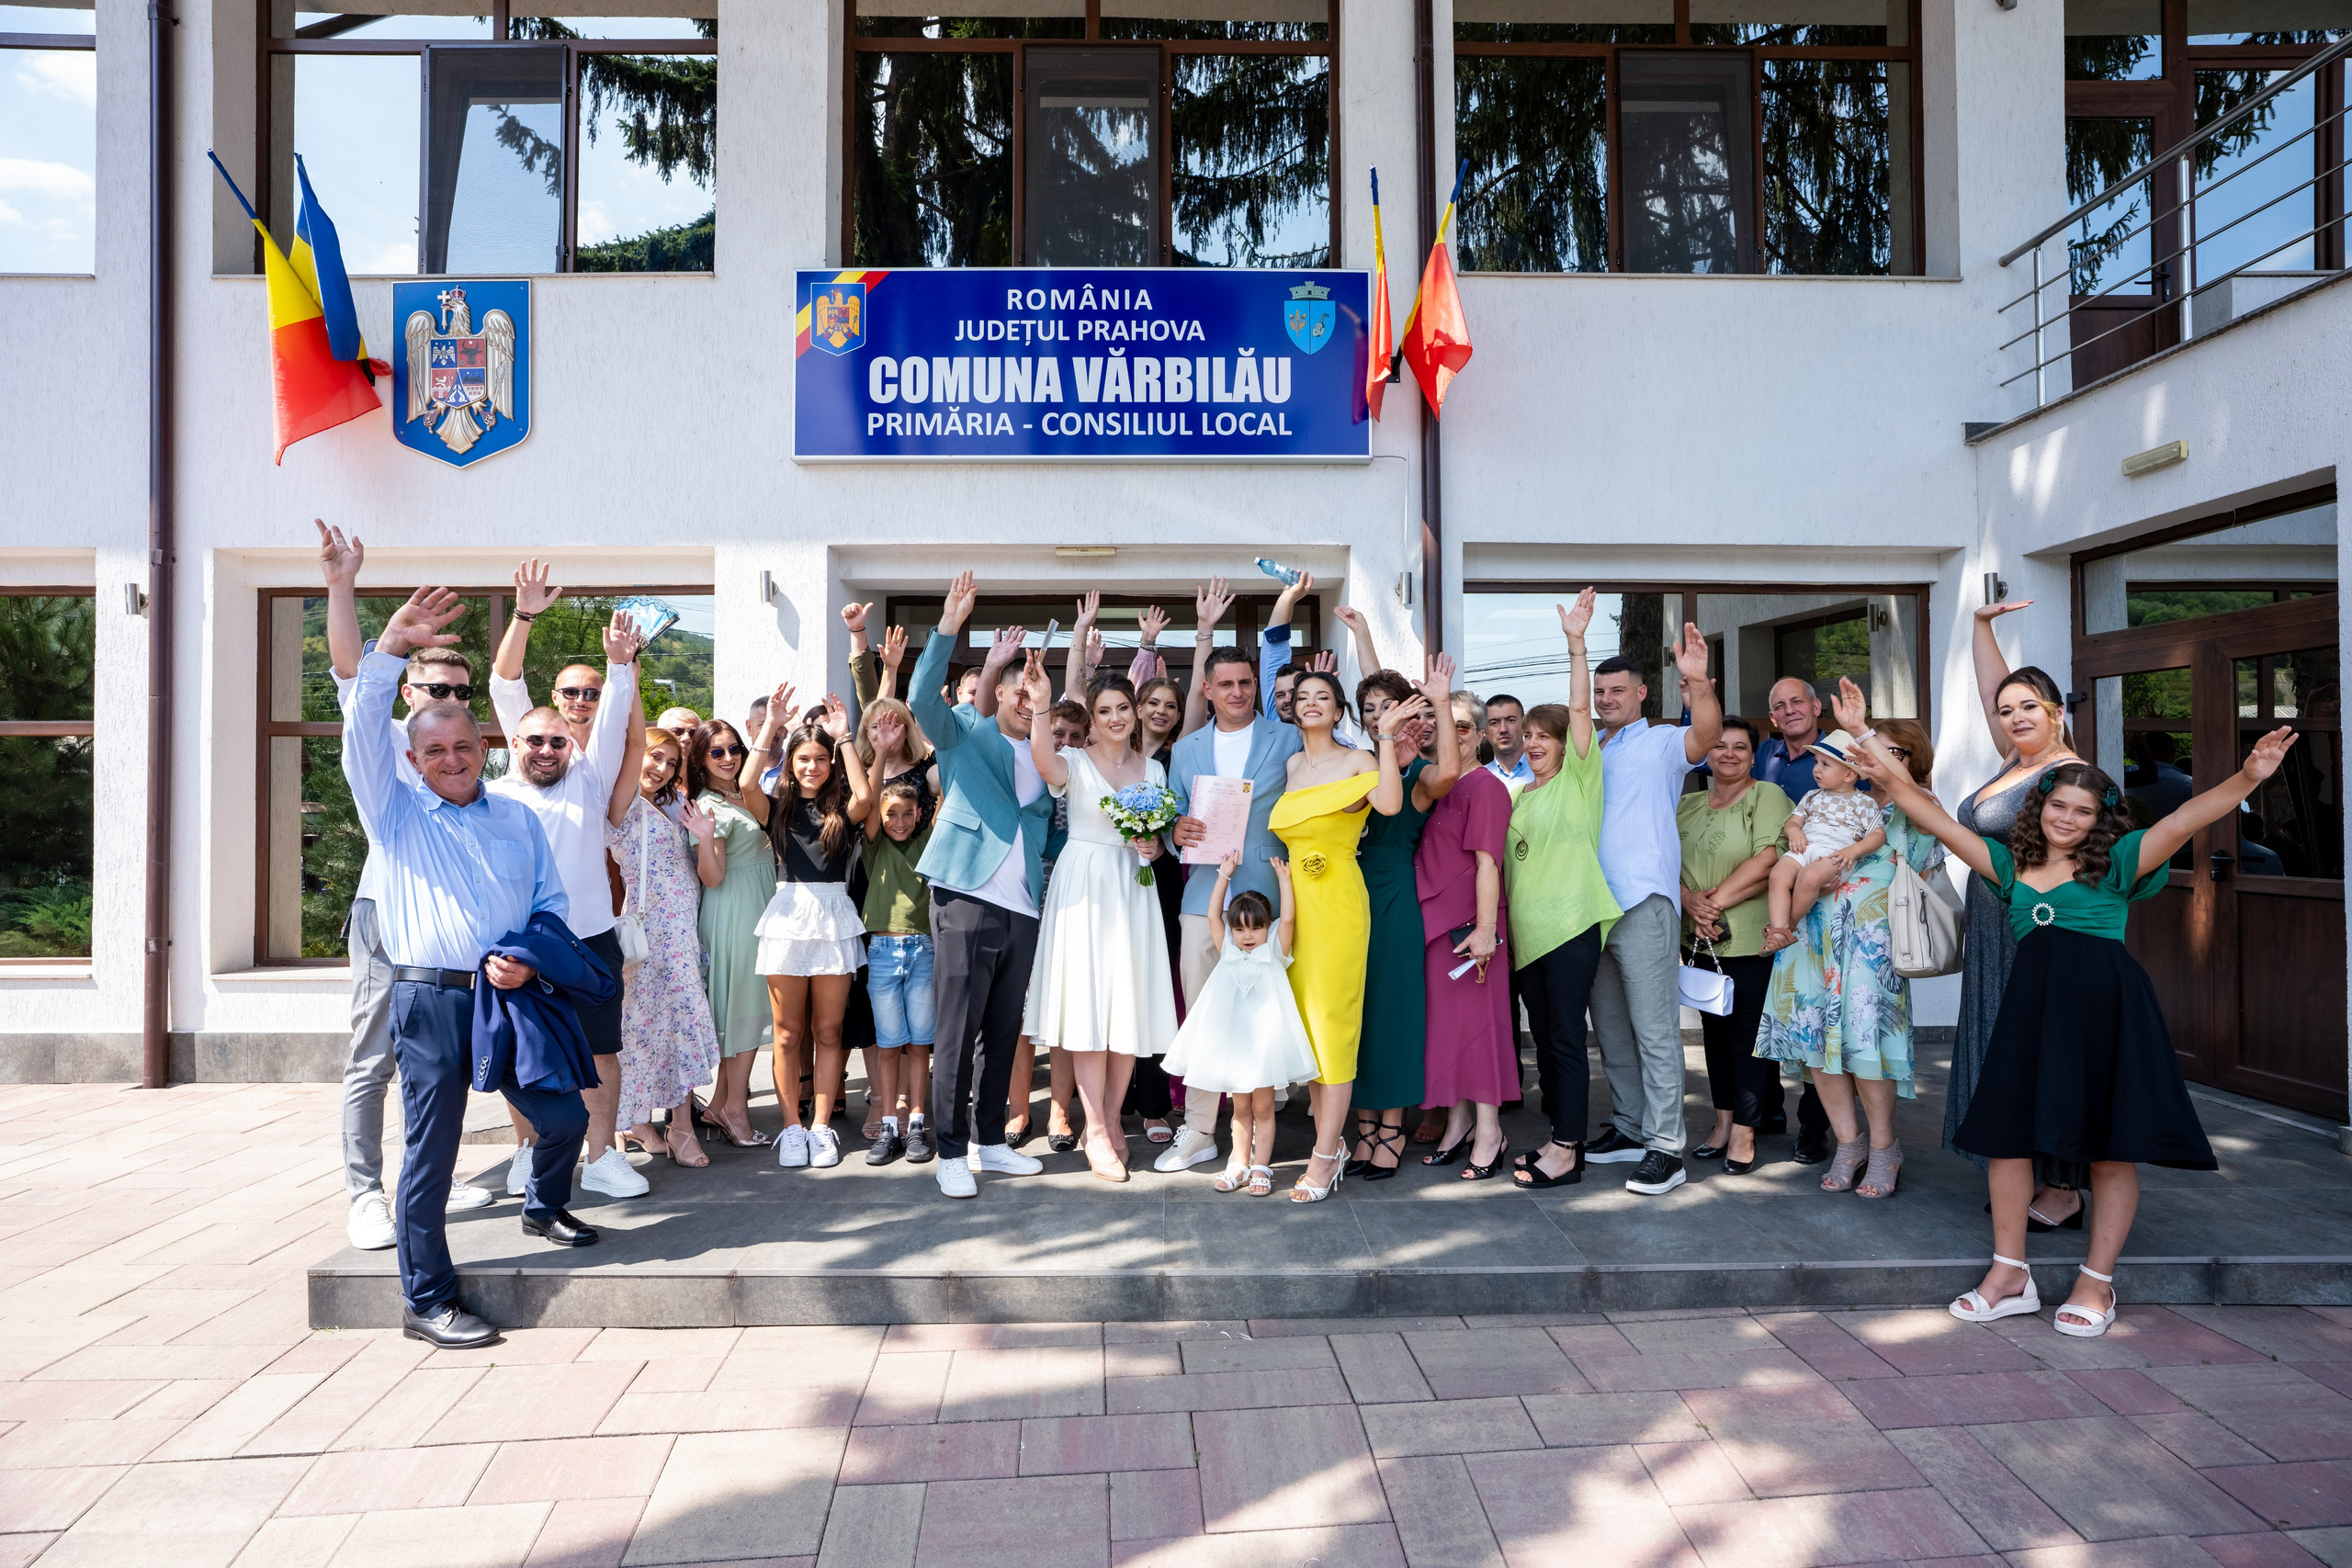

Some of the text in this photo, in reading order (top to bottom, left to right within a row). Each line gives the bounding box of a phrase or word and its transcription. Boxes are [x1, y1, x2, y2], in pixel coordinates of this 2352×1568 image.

[1007, 283, 1153, 310] ROMÂNIA
[955, 320, 1206, 346] JUDEȚUL PRAHOVA
[868, 347, 1292, 404] COMUNA VĂRBILĂU
[867, 406, 1015, 436] PRIMĂRIA
[1041, 412, 1193, 436] CONSILIUL
[1202, 412, 1293, 436] LOCAL
